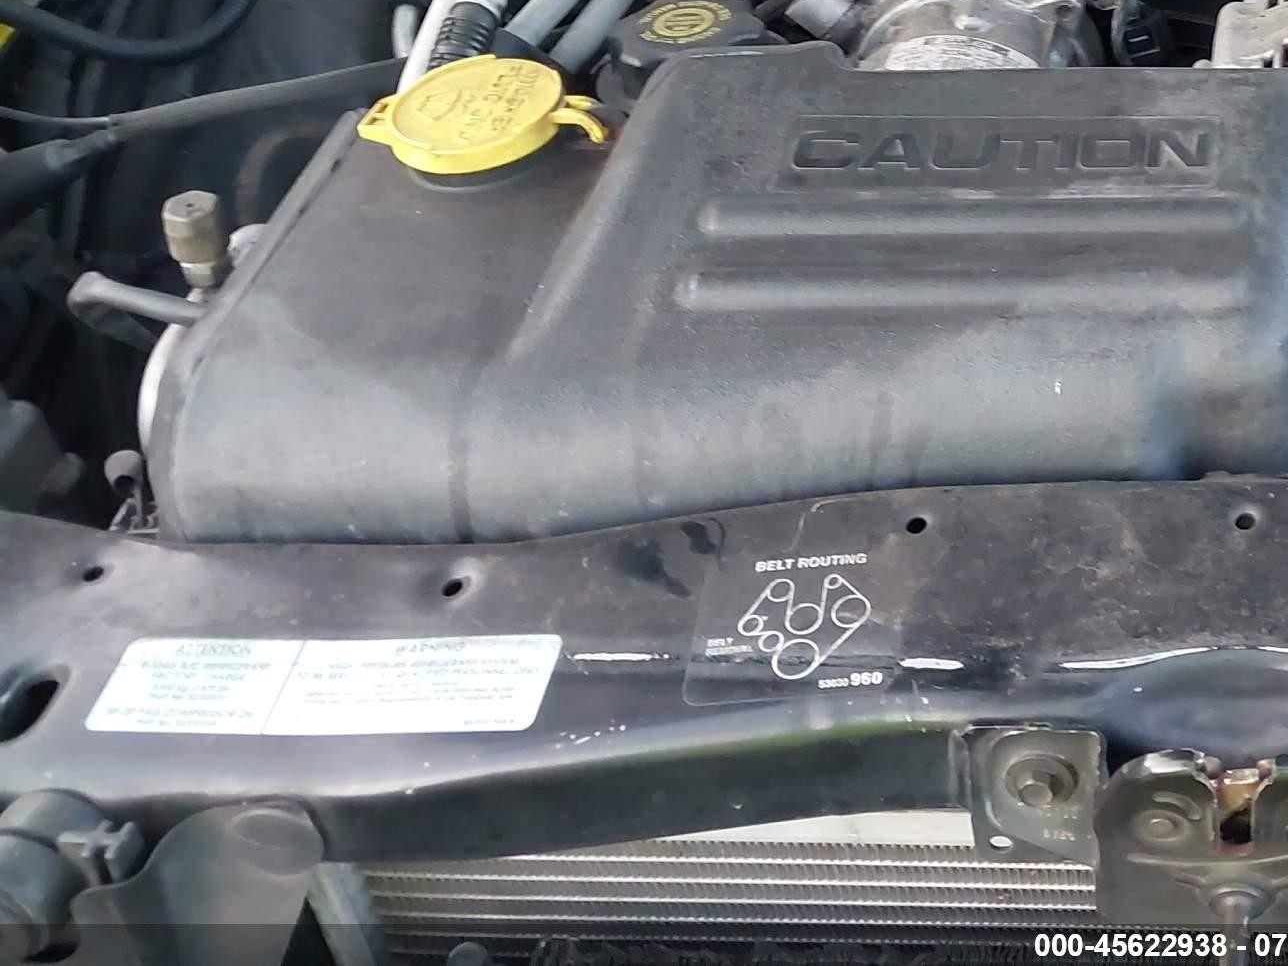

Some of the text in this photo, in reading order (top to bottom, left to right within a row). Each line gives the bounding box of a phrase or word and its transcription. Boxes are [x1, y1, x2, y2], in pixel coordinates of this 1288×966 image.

[791, 130, 1213, 170] CAUTION
[755, 552, 868, 573] BELT ROUTING
[850, 671, 884, 687] 960
